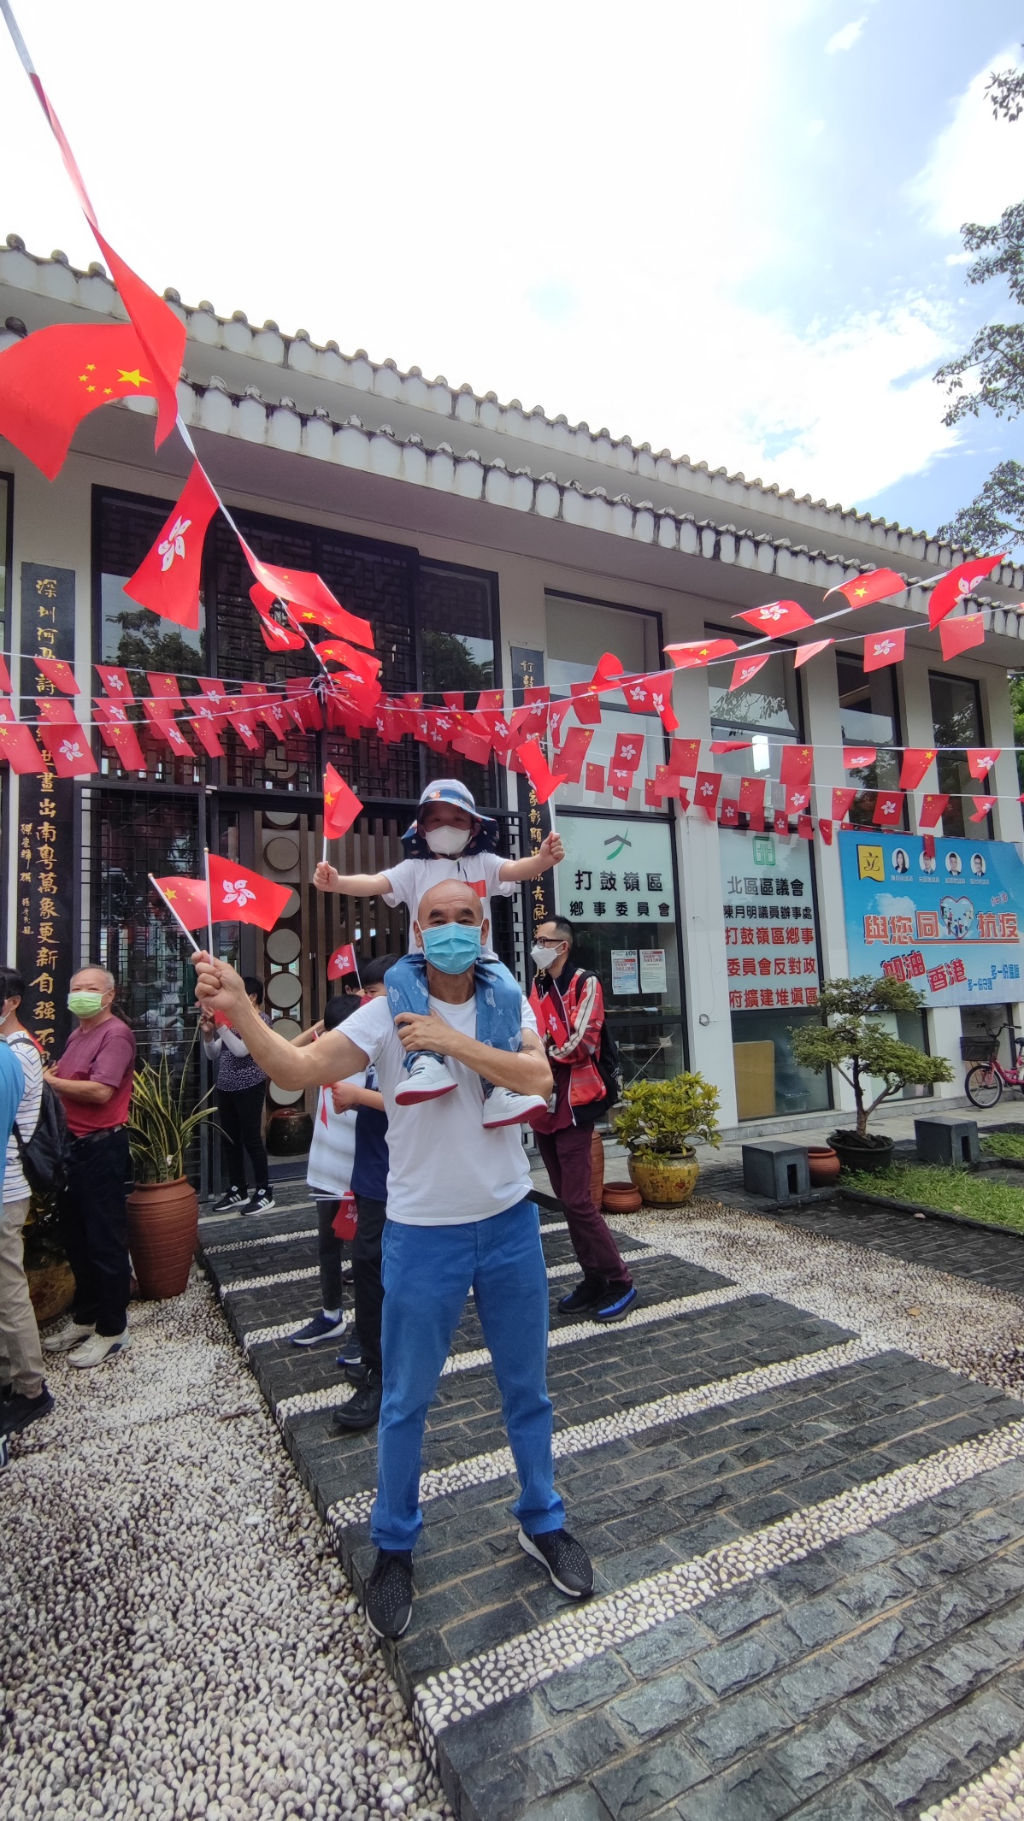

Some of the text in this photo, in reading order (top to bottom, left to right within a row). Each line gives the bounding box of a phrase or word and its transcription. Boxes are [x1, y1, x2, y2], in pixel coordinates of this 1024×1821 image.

[575, 870, 663, 892] 打鼓嶺區
[727, 876, 804, 897] 北區區議會
[569, 901, 670, 917] 鄉事委員會
[723, 904, 813, 920] 陳月明議員辦事處
[725, 926, 814, 946] 打鼓嶺區鄉事
[863, 911, 1019, 945] 與您同 抗疫
[727, 957, 817, 977] 委員會反對政
[880, 950, 967, 992] 加油 香港
